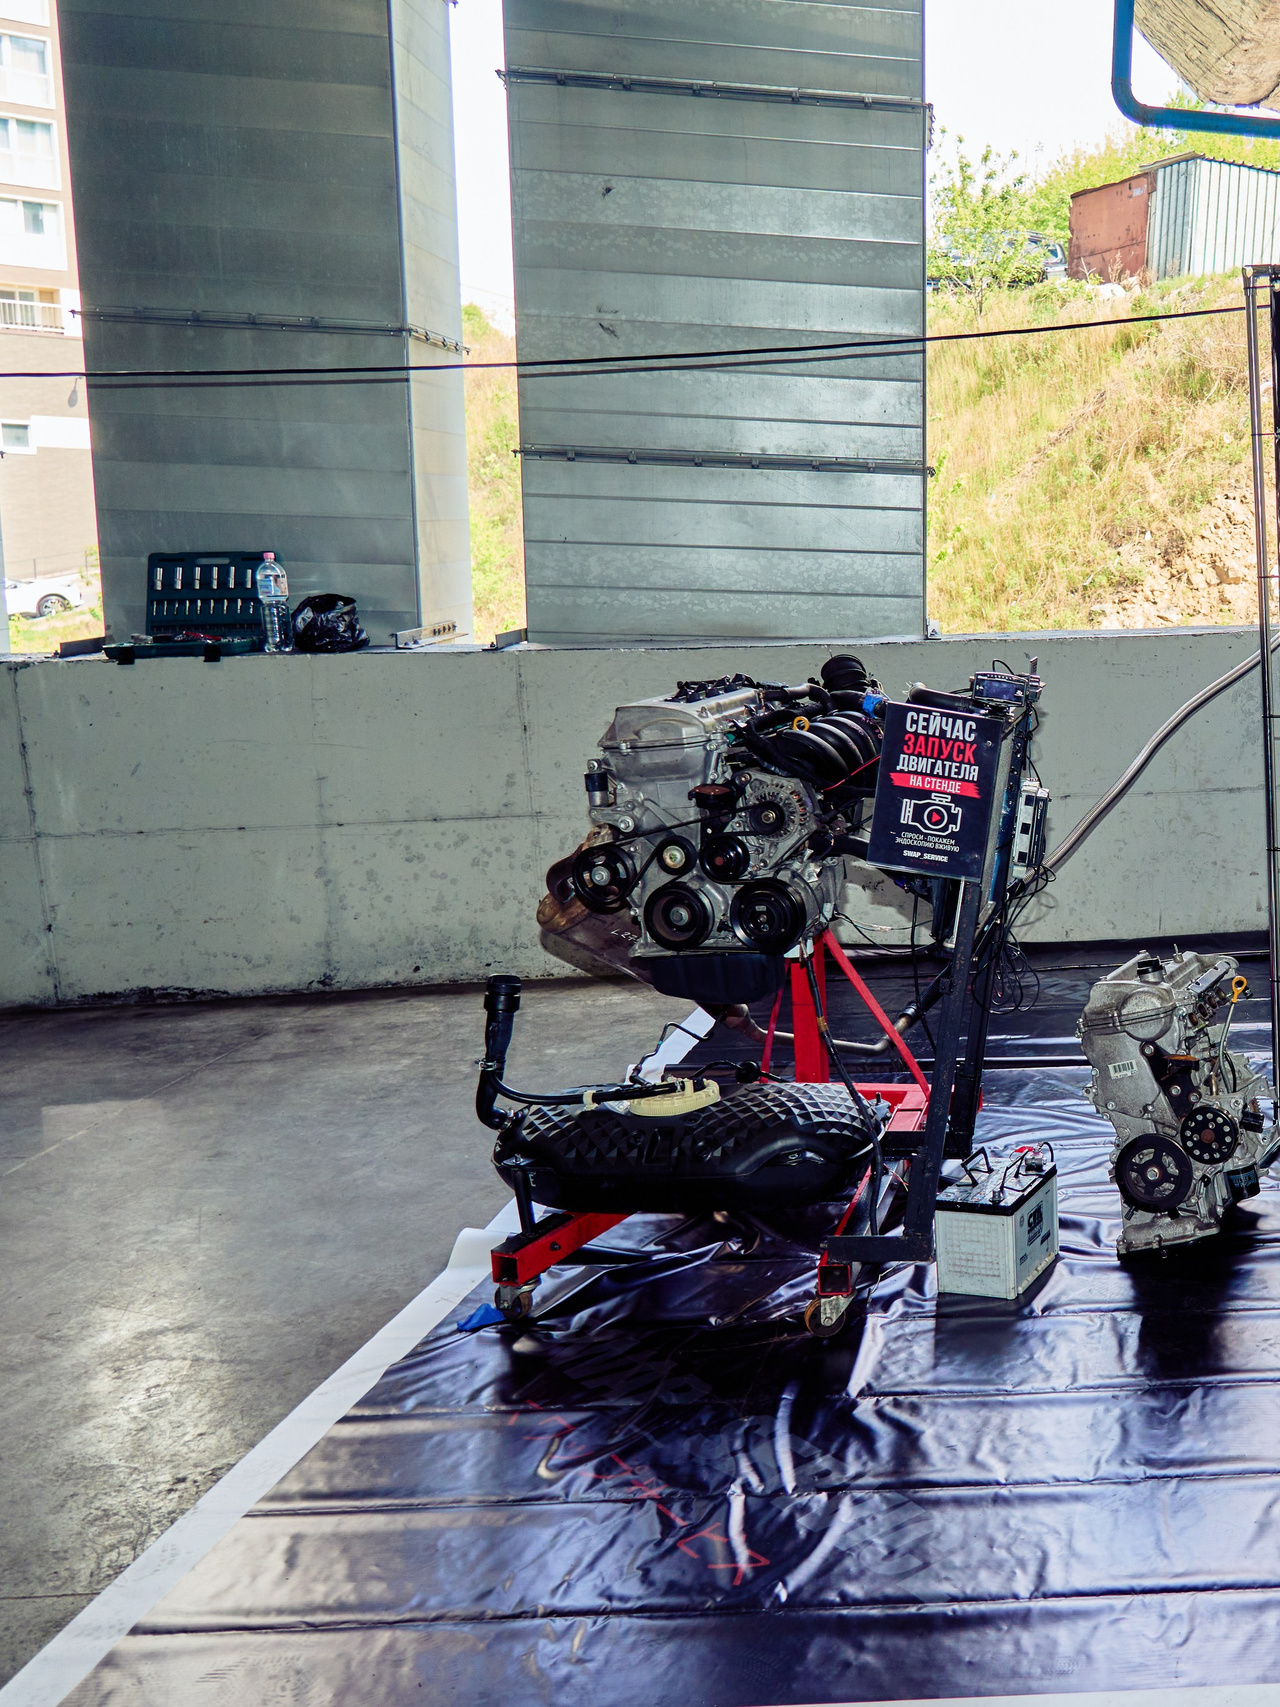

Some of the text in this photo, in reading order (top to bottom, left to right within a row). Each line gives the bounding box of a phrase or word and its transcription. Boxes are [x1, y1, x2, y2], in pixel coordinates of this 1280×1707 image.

[906, 711, 976, 741] СЕЙЧАС
[903, 733, 977, 764] ЗАПУСК
[896, 753, 979, 781] ДВИГАТЕЛЯ
[909, 775, 961, 793] НА СТЕНДЕ
